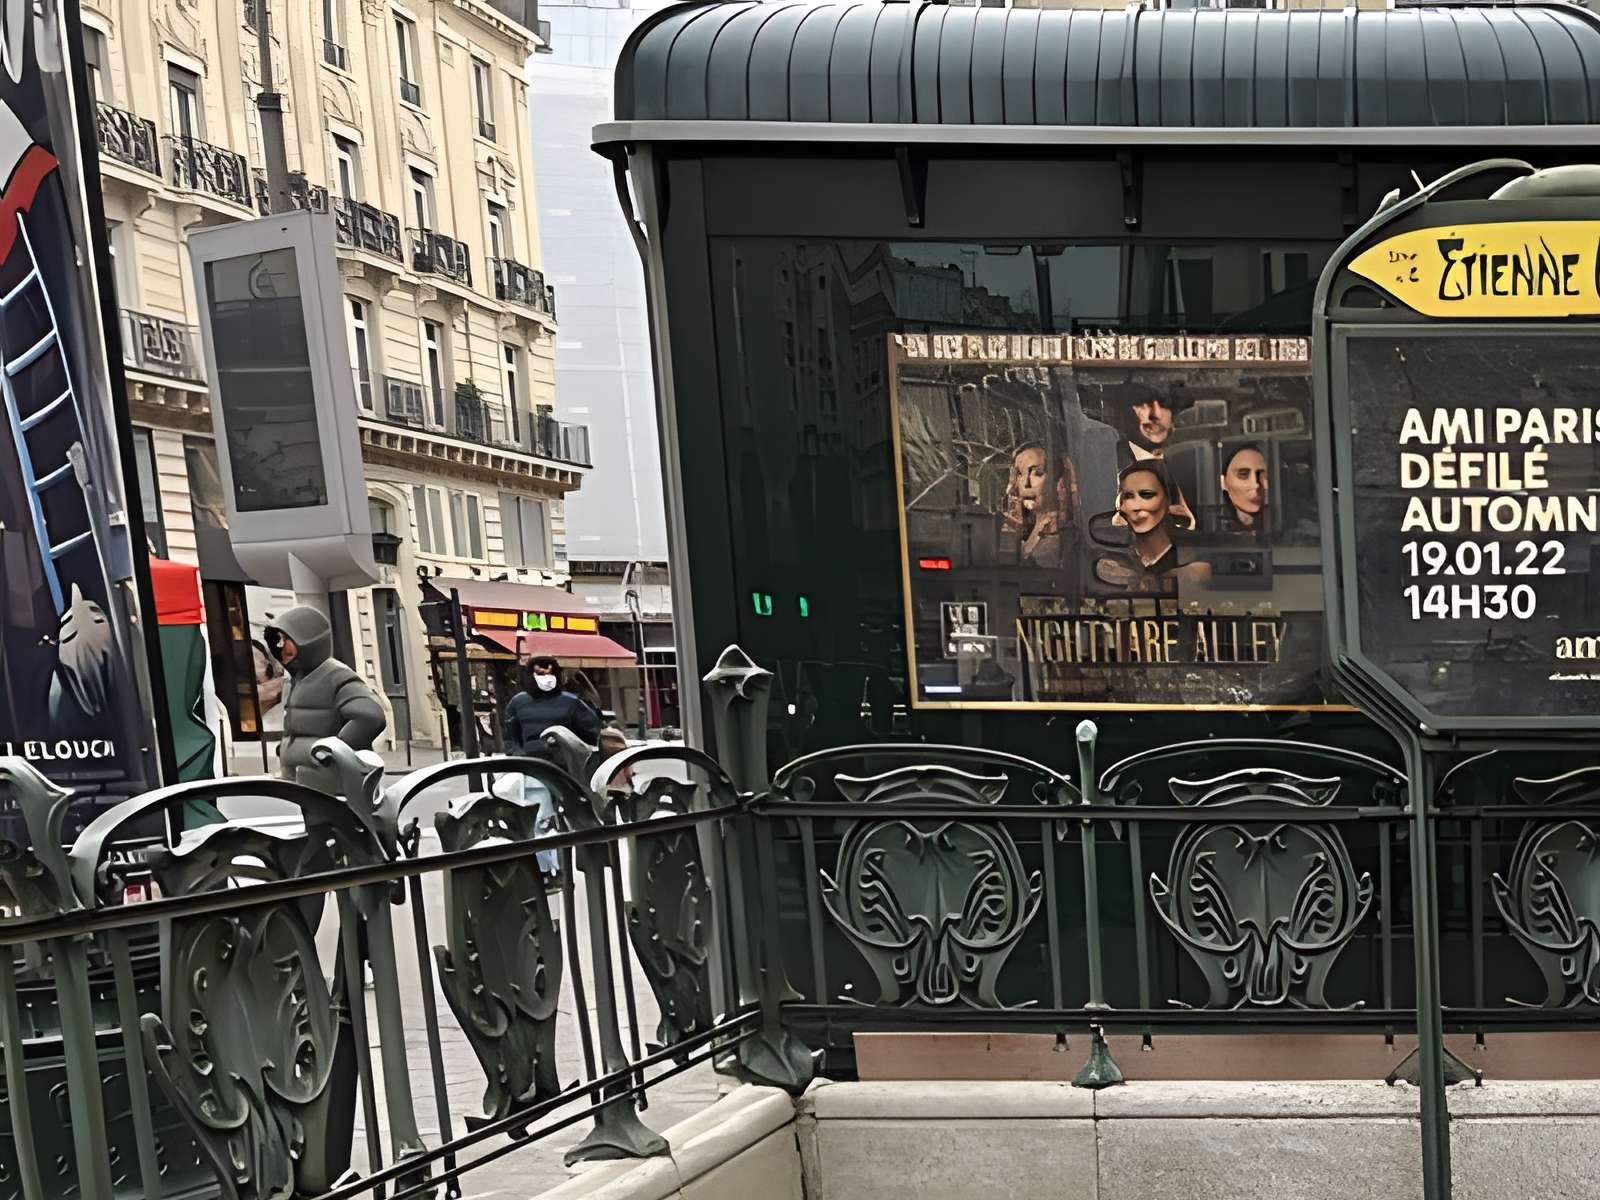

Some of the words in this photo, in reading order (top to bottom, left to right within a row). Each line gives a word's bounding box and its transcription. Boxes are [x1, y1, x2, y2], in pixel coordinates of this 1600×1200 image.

[1399, 408, 1484, 444] AMI
[1401, 444, 1549, 490] DÉFILÉ
[1402, 540, 1566, 577] 19.01.22
[1403, 584, 1537, 620] 14H30
